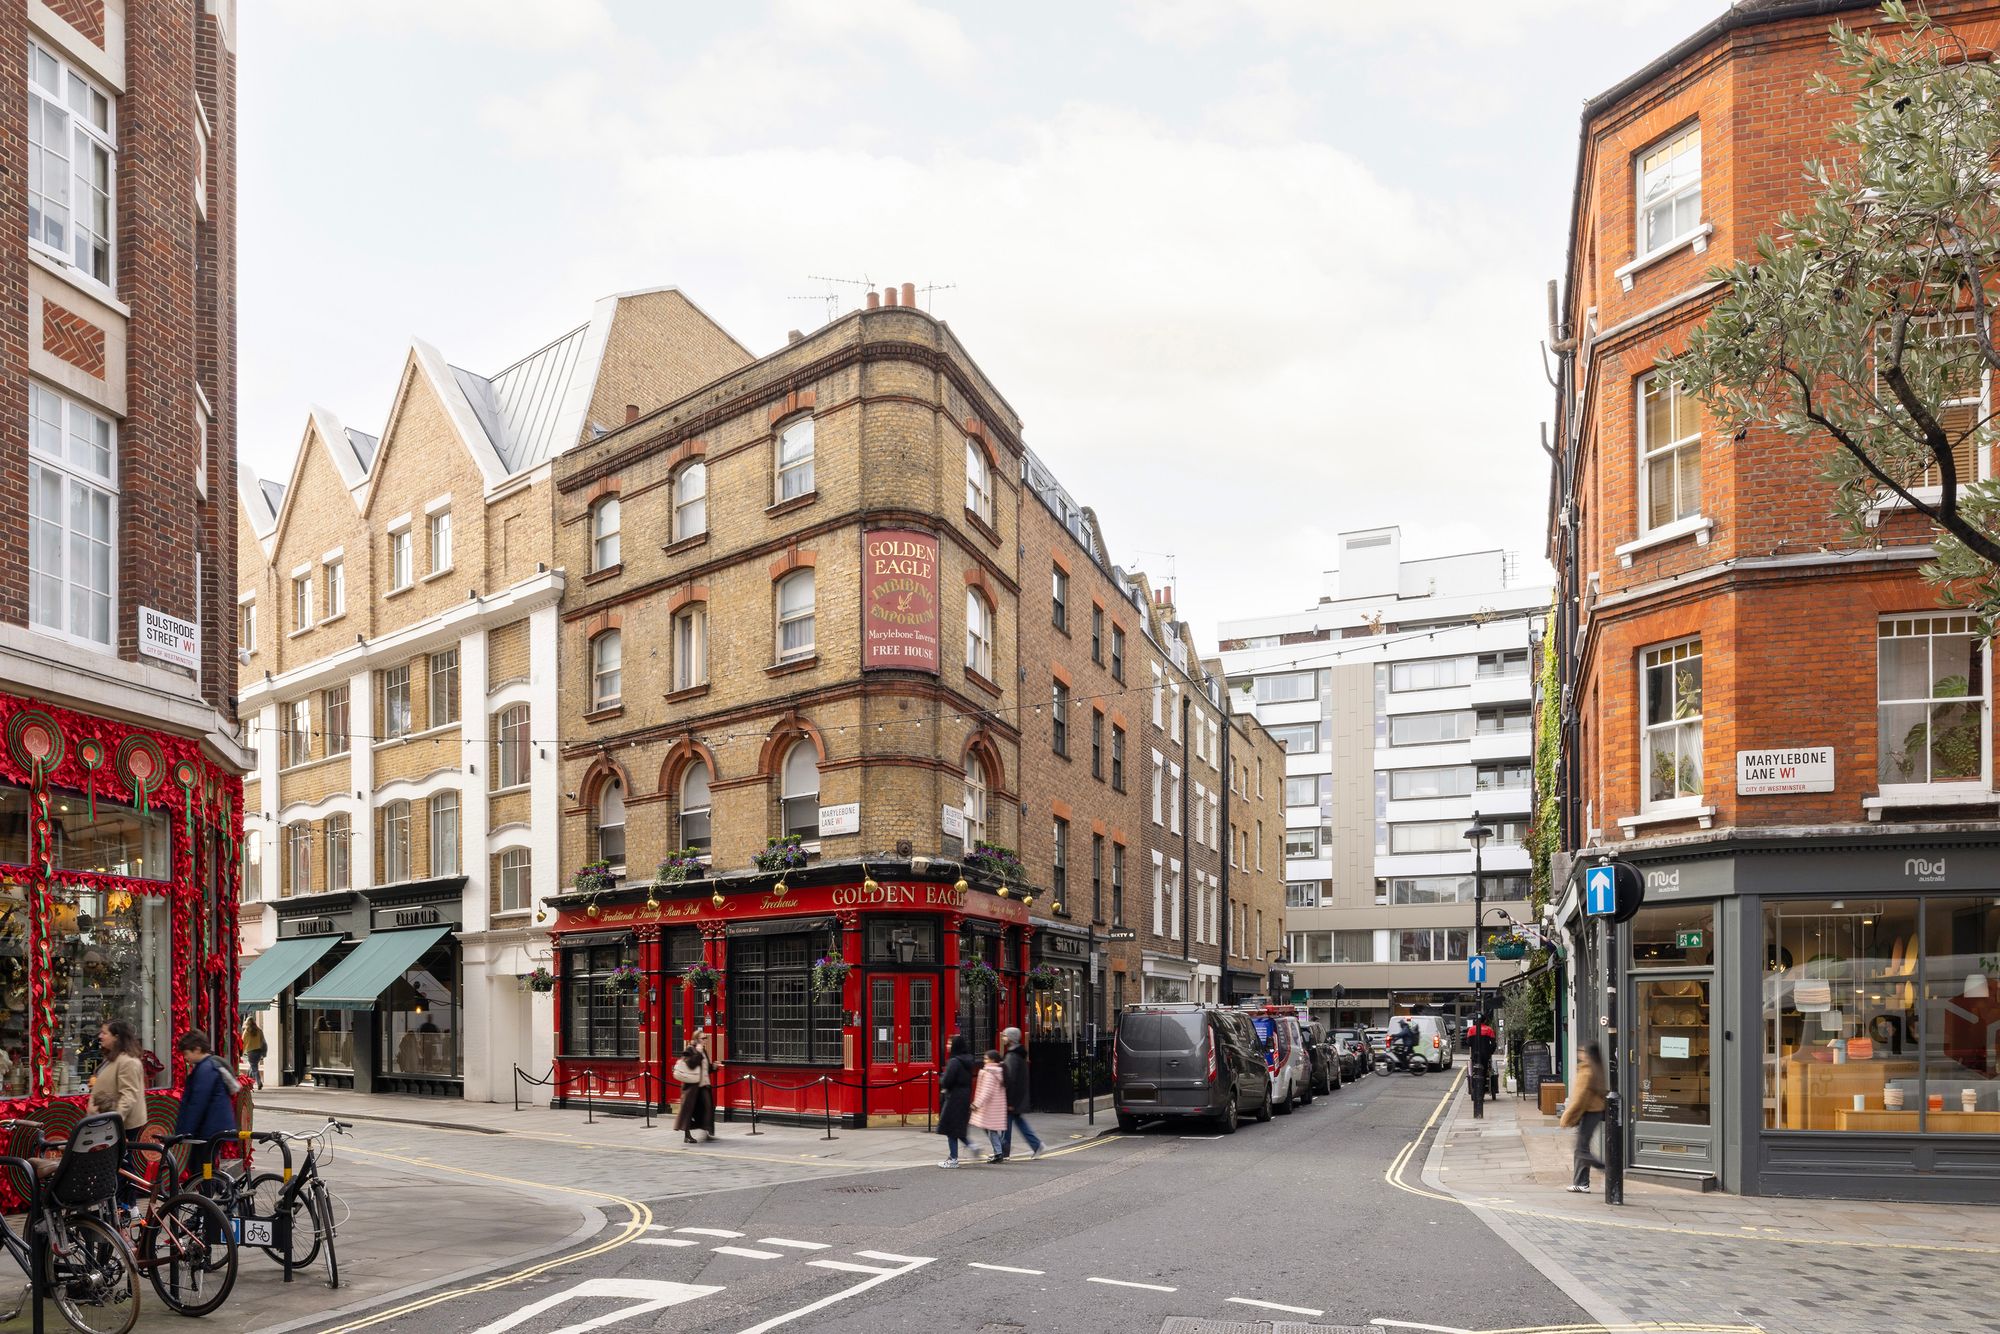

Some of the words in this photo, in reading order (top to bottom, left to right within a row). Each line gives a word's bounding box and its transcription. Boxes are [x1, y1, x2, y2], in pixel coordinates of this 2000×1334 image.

[868, 541, 936, 563] GOLDEN
[874, 559, 932, 579] EAGLE
[872, 578, 934, 604] IMBIBING
[870, 603, 934, 625] EMPORIUM
[146, 612, 195, 640] BULSTRODE
[146, 627, 179, 648] STREET
[183, 639, 195, 655] W1
[868, 628, 914, 641] Marylebone
[914, 629, 936, 644] Tavern
[146, 646, 157, 654] CITY
[872, 645, 900, 656] FREE
[904, 646, 934, 660] HOUSE
[1745, 751, 1827, 766] MARYLEBONE
[1745, 767, 1775, 780] LANE
[1780, 767, 1796, 779] W1
[1767, 784, 1806, 792] WESTMINSTER
[821, 806, 855, 818] MARYLEBONE
[821, 818, 834, 827] LANE
[832, 885, 915, 905] GOLDEN
[601, 908, 637, 922] Traditional
[664, 904, 681, 917] Run
[683, 902, 701, 915] Pub
[1056, 937, 1078, 953] SIXTY
